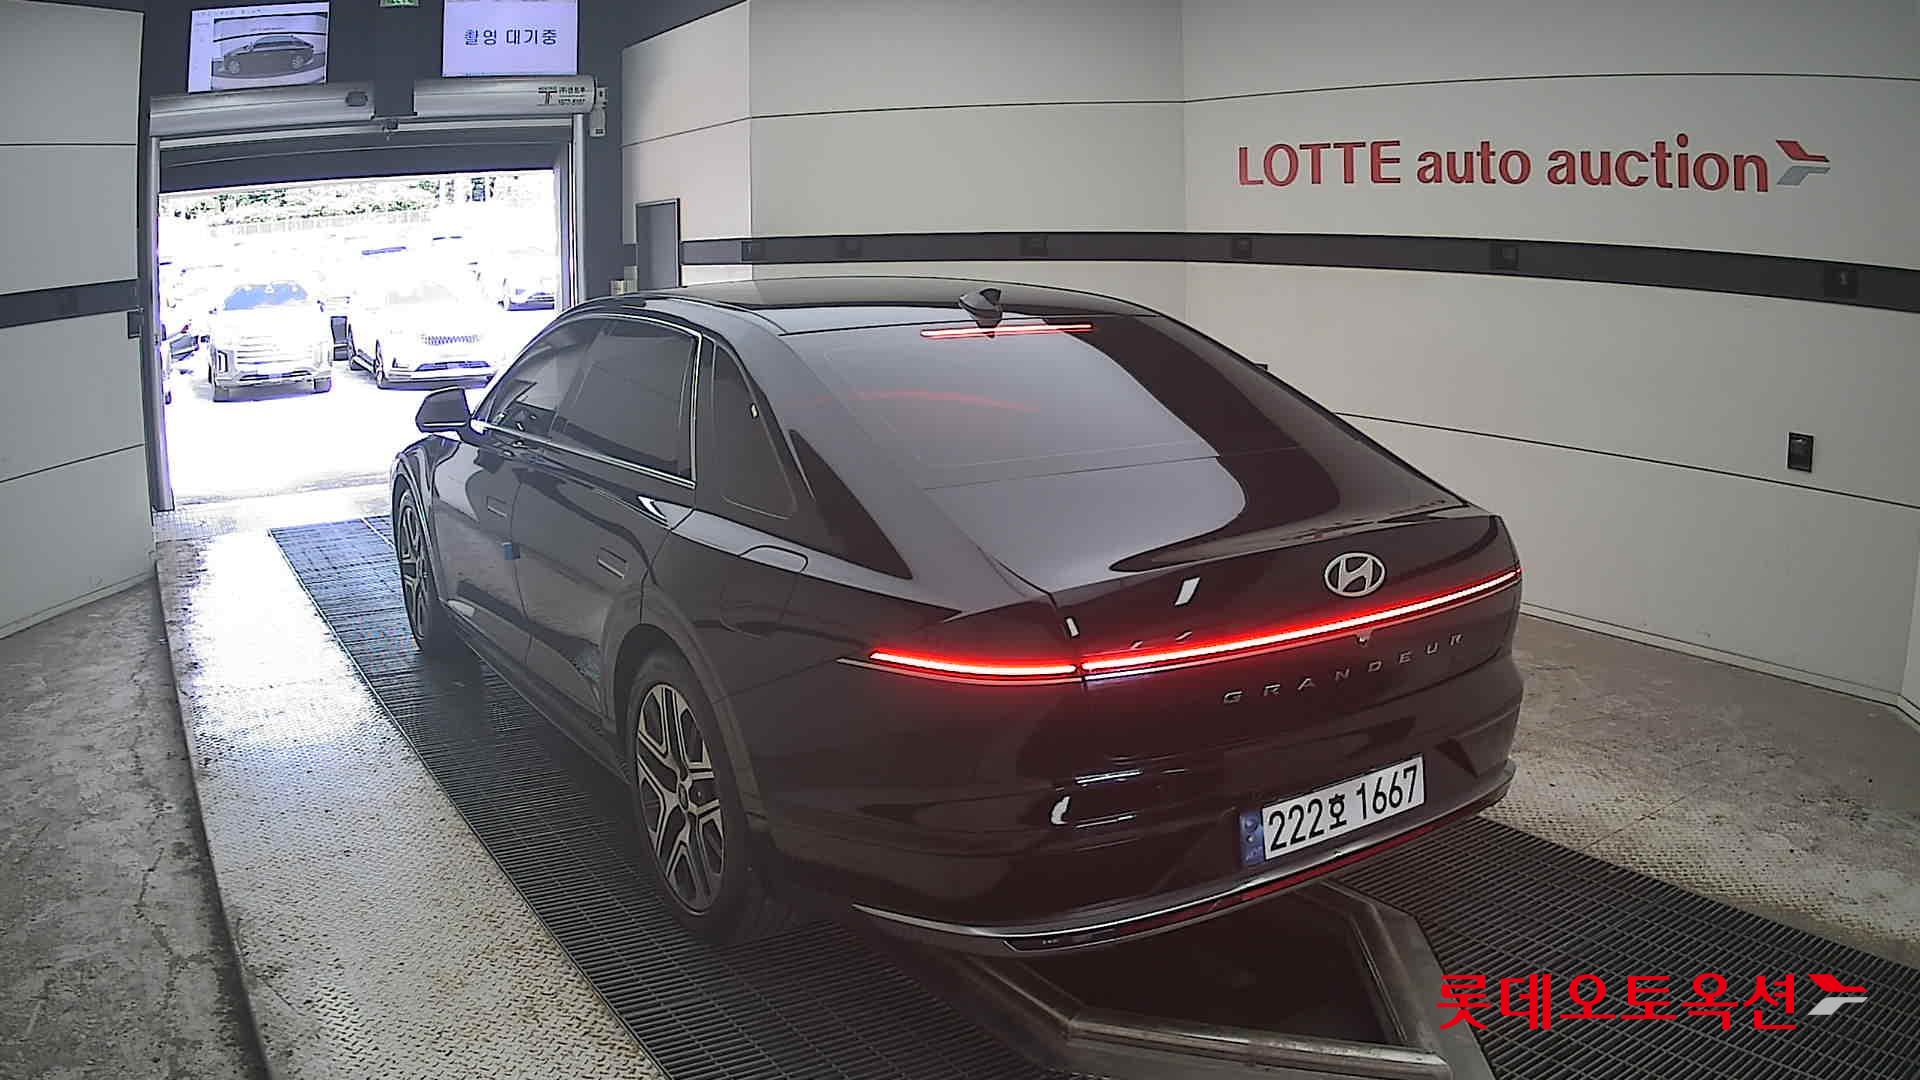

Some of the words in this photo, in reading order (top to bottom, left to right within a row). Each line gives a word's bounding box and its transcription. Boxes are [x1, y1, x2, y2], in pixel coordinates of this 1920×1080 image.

[506, 28, 558, 46] 대기중
[1238, 139, 1401, 187] LOTTE
[1416, 140, 1531, 185] auto
[1546, 132, 1769, 193] auction
[1223, 633, 1464, 704] GRANDEUR
[1268, 793, 1348, 851] 222호
[1356, 764, 1418, 820] 1667
